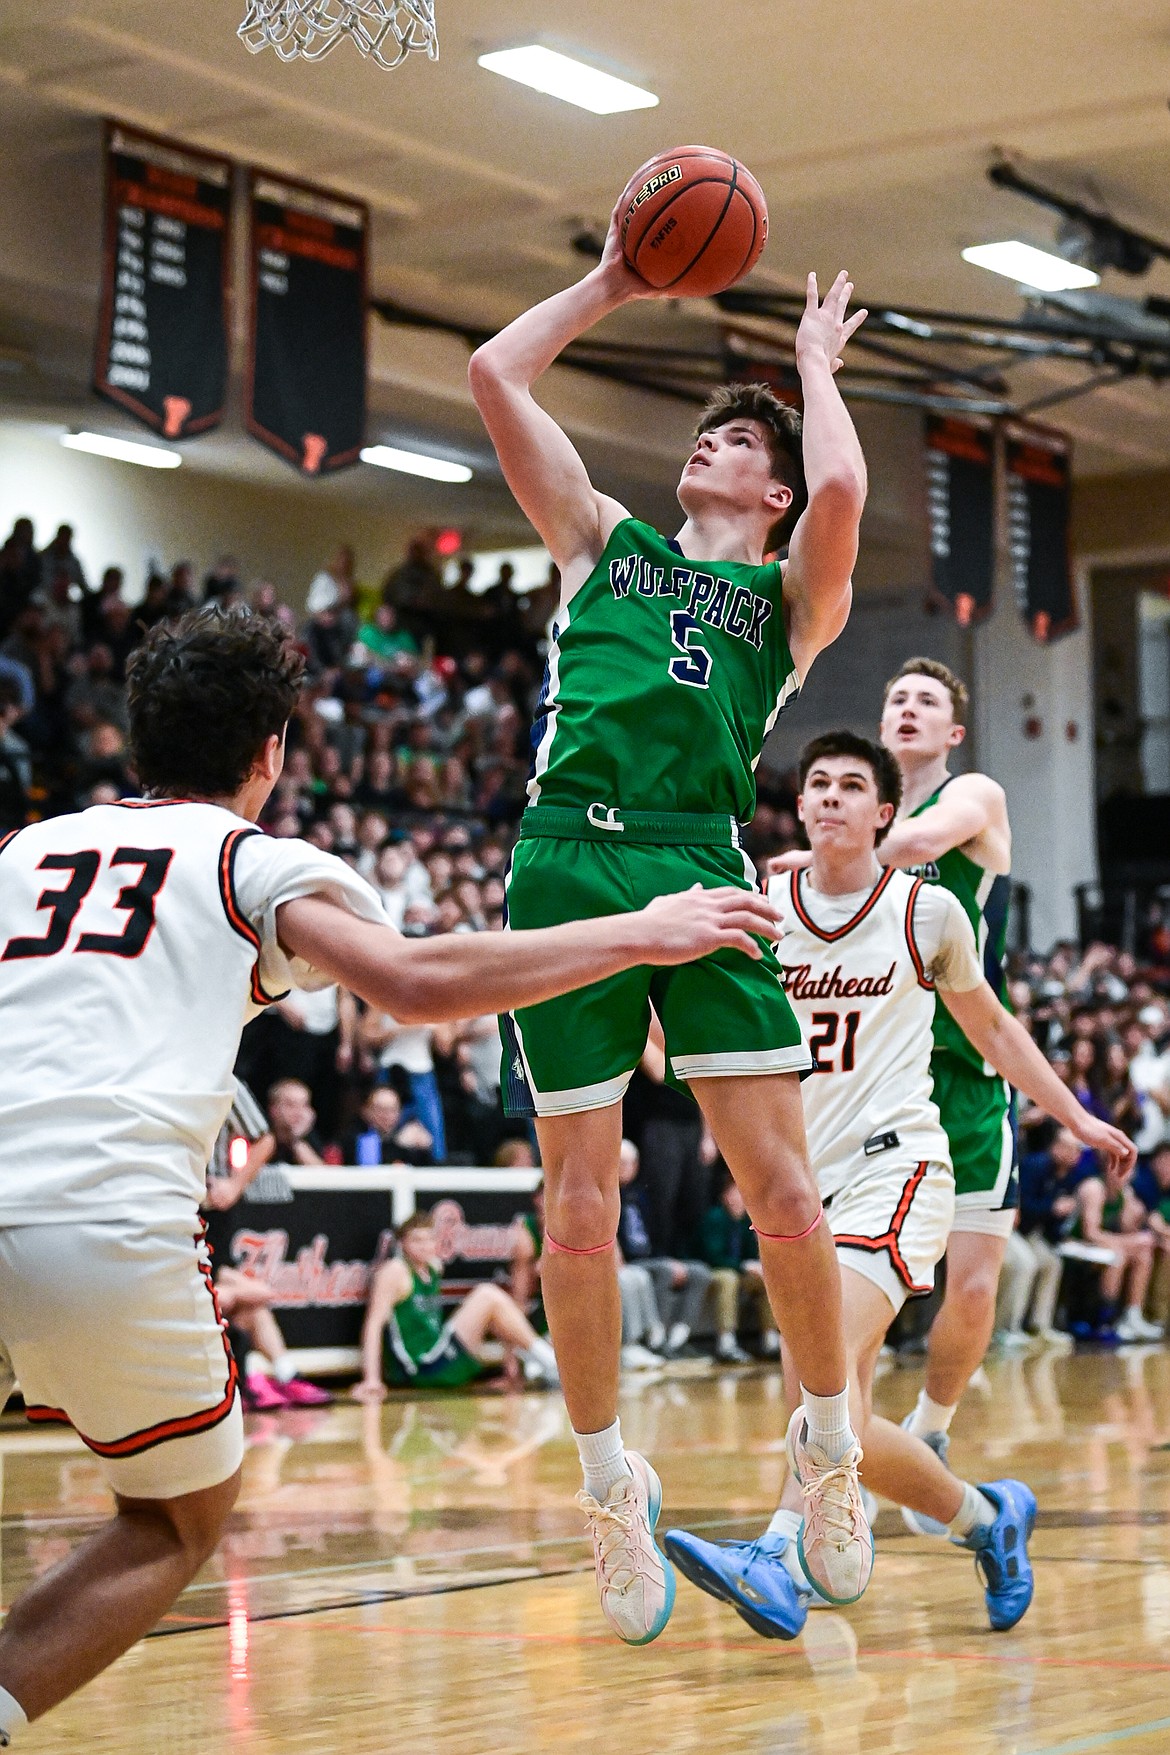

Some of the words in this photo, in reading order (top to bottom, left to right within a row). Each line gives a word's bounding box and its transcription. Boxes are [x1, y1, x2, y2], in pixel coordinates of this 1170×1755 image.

[668, 610, 713, 689] 5
[0, 846, 175, 961] 33
[781, 961, 897, 1000] Flathead
[809, 1011, 861, 1073] 21
